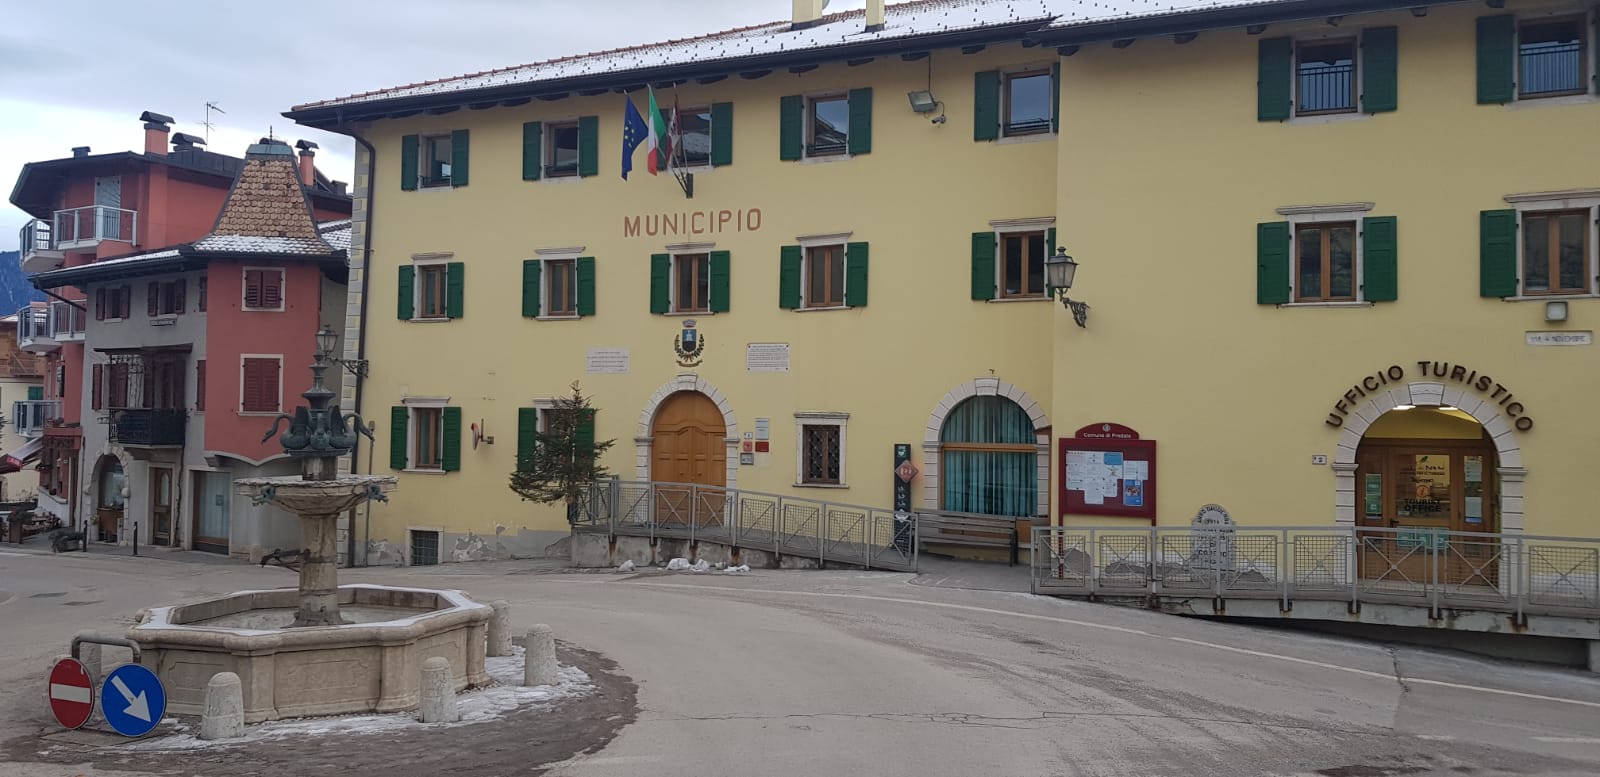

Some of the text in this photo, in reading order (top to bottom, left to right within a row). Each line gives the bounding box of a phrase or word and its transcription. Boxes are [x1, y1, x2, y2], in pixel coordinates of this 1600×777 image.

[624, 208, 762, 238] MUNICIPIO
[1325, 361, 1533, 432] UFFICIO TURISTICO
[1404, 504, 1441, 512] OFFICE
